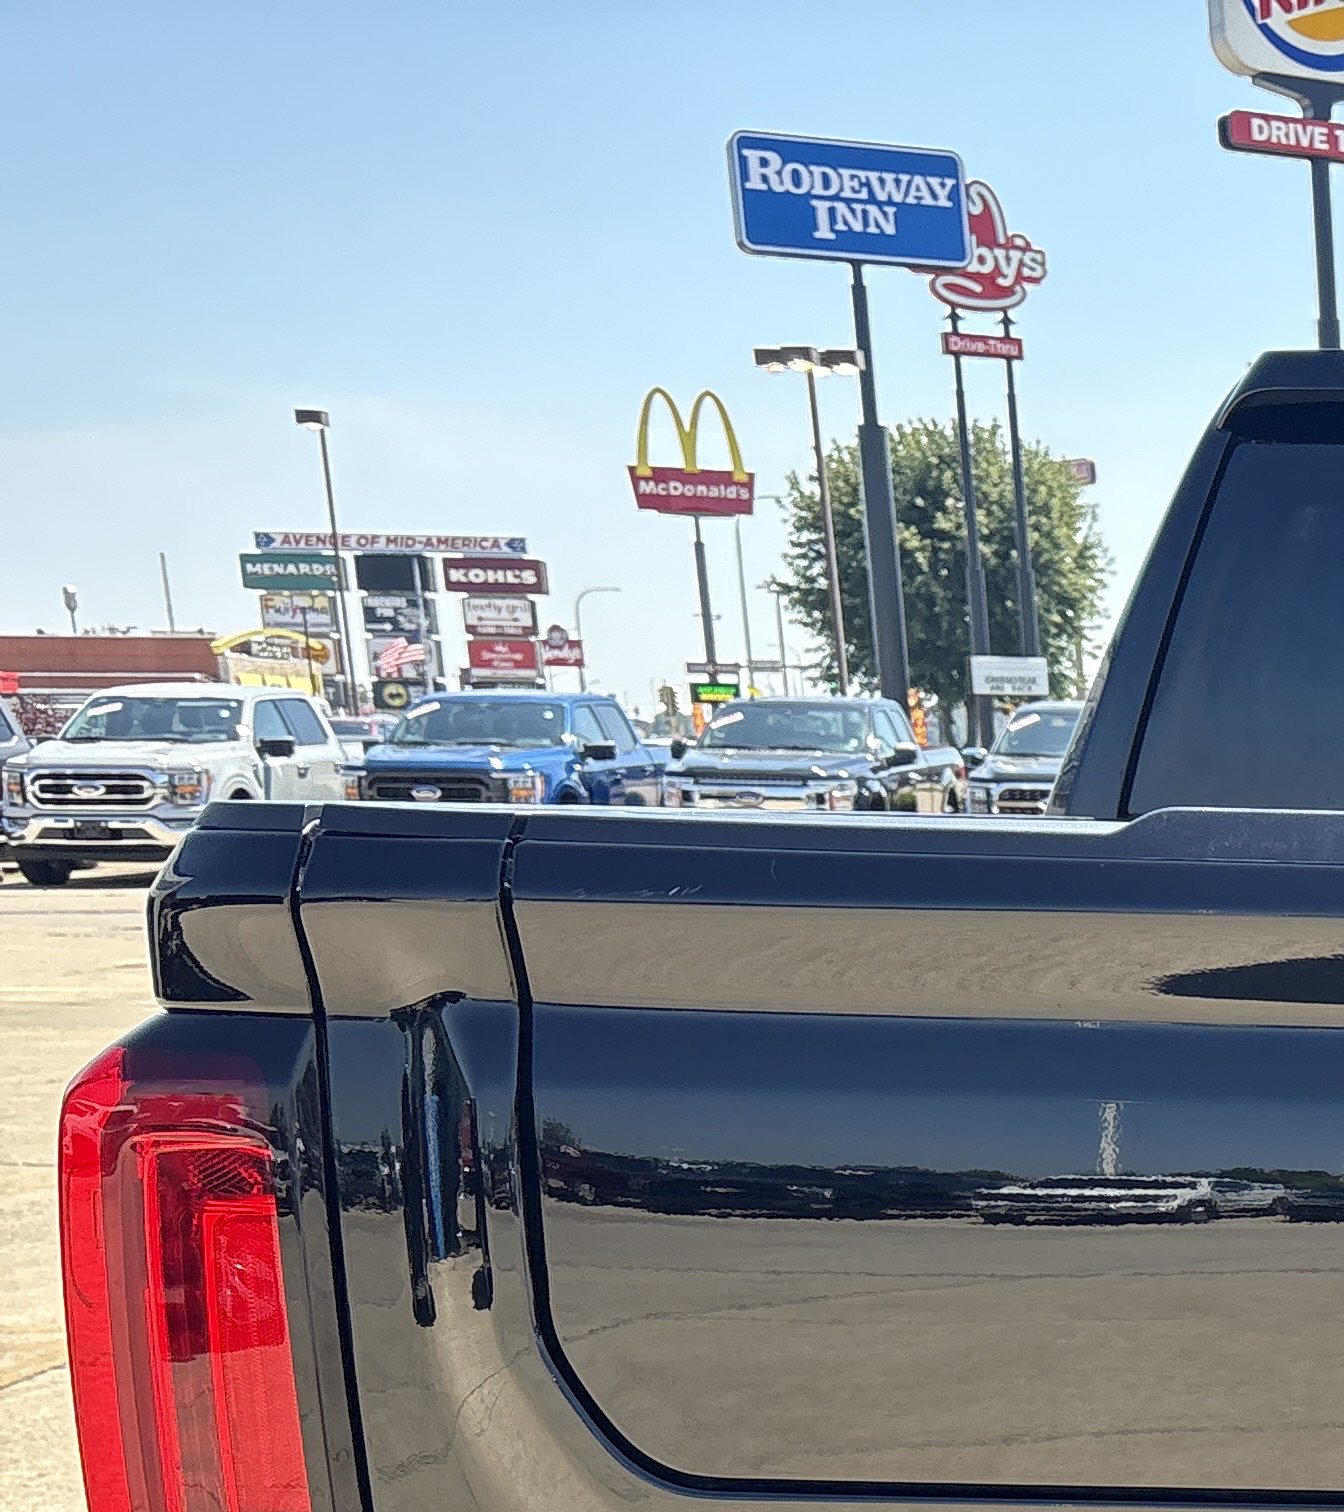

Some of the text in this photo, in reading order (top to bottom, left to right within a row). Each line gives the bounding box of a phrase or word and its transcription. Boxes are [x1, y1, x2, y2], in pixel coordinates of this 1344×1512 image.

[1250, 117, 1330, 150] DRIVE
[809, 199, 898, 240] INN
[966, 233, 1046, 288] by's
[638, 479, 750, 500] McDonald's
[356, 535, 381, 549] OF
[385, 535, 502, 551] MID-AMERICA
[245, 562, 338, 576] MENARDS
[448, 567, 538, 584] KOHL'S
